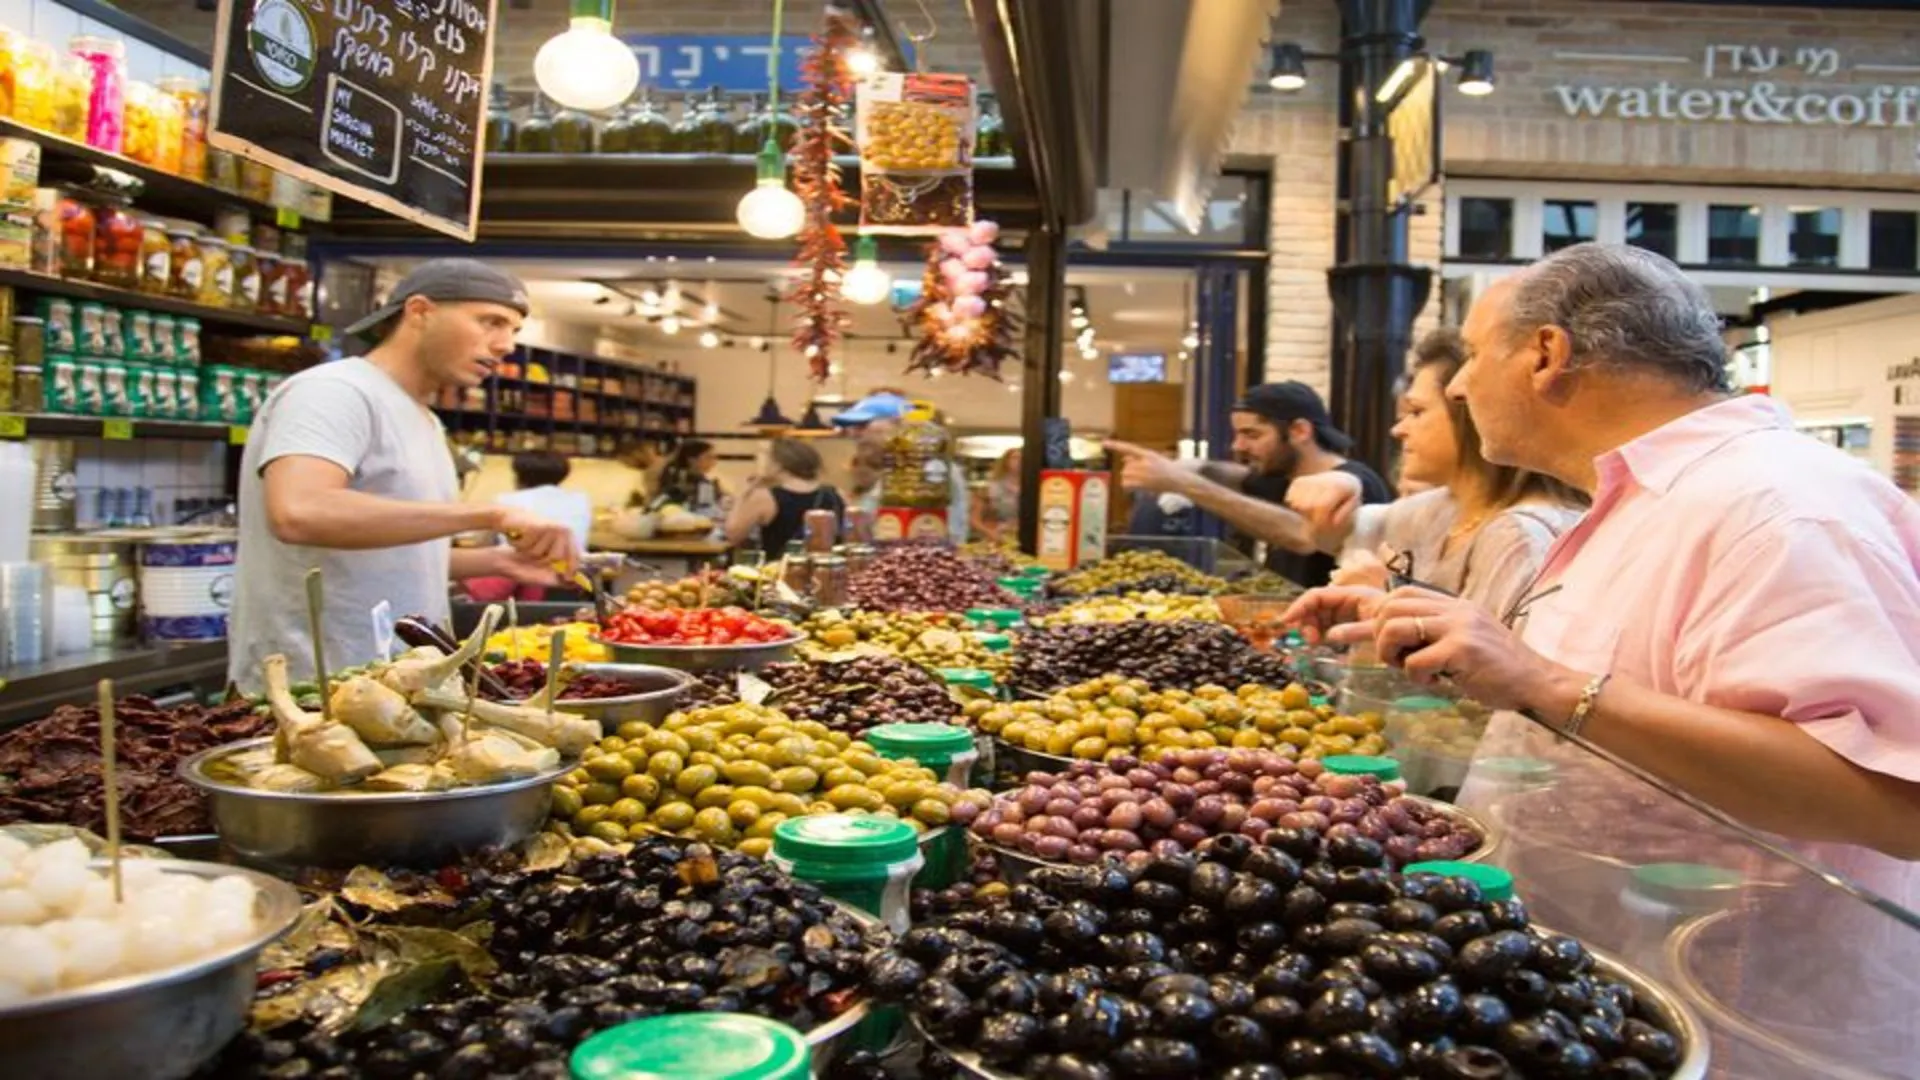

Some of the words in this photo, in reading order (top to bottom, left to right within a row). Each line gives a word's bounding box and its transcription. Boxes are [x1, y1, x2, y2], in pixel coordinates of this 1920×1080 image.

[1703, 43, 1779, 79] עדן
[1796, 45, 1840, 77] מי
[1554, 80, 1920, 127] water&coff
